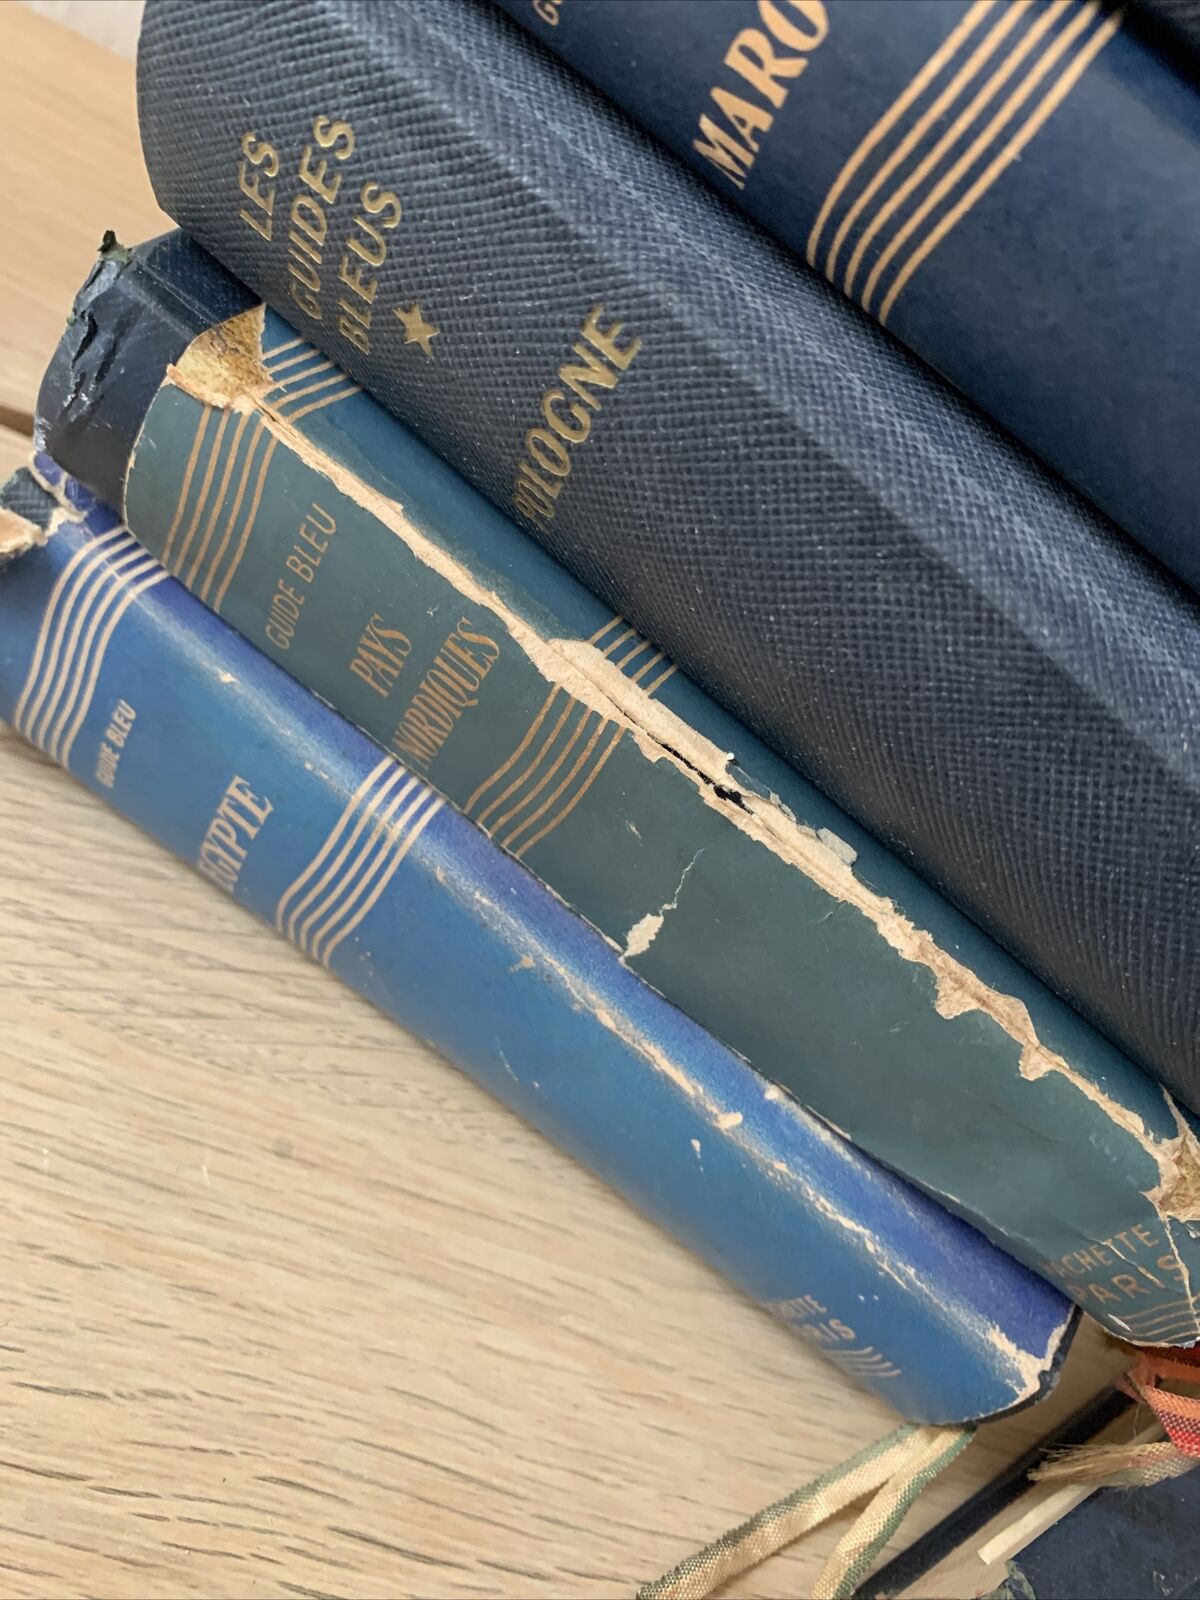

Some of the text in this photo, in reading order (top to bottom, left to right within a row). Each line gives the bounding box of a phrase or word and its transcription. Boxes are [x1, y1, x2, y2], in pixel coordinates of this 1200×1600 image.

[239, 131, 280, 242] LES
[288, 114, 356, 321] GUIDES
[337, 181, 403, 356] BLEUS
[511, 302, 644, 534] POLOGNE
[265, 502, 338, 651] GUIDE BLEU
[104, 697, 138, 749] BLEU
[349, 612, 413, 699] PAYS
[391, 615, 501, 771] NORDIQUES
